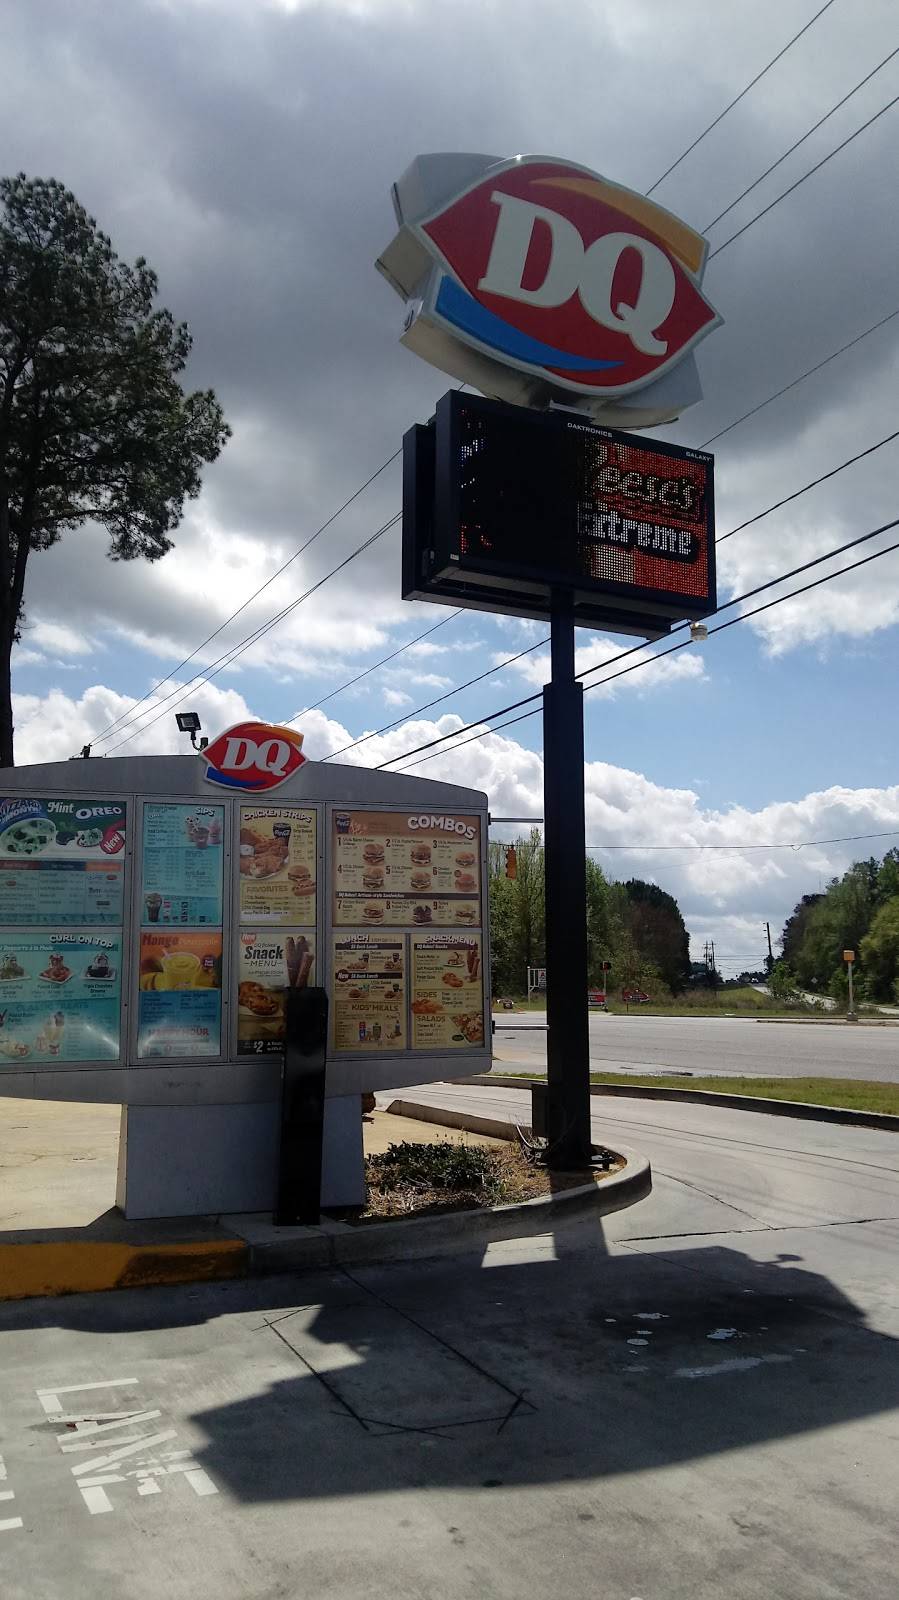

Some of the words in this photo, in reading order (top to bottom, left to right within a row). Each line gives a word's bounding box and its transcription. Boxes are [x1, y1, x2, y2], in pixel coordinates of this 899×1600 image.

[477, 190, 676, 356] DQ
[567, 422, 613, 438] DAKTRONICS
[686, 451, 709, 461] GALAXY
[220, 736, 286, 776] DQ
[47, 801, 75, 814] Mint
[75, 806, 122, 820] OREO
[195, 807, 216, 816] SIPS
[243, 809, 280, 820] CHICKEN
[282, 810, 312, 824] STRIPS
[408, 816, 476, 839] COMBOS
[103, 833, 121, 851] New
[337, 837, 342, 846] 1
[386, 838, 391, 848] 2
[433, 840, 438, 848] 3
[337, 865, 342, 874] 4
[386, 866, 390, 874] 5
[433, 867, 438, 876] 6
[338, 900, 342, 909] 7
[386, 900, 390, 910] 8
[433, 901, 438, 910] 9
[50, 935, 77, 944] CURL
[78, 936, 92, 944] ON
[96, 938, 114, 948] TOP
[143, 934, 180, 948] Mango
[245, 946, 284, 959] Snack
[254, 1040, 264, 1052] $2
